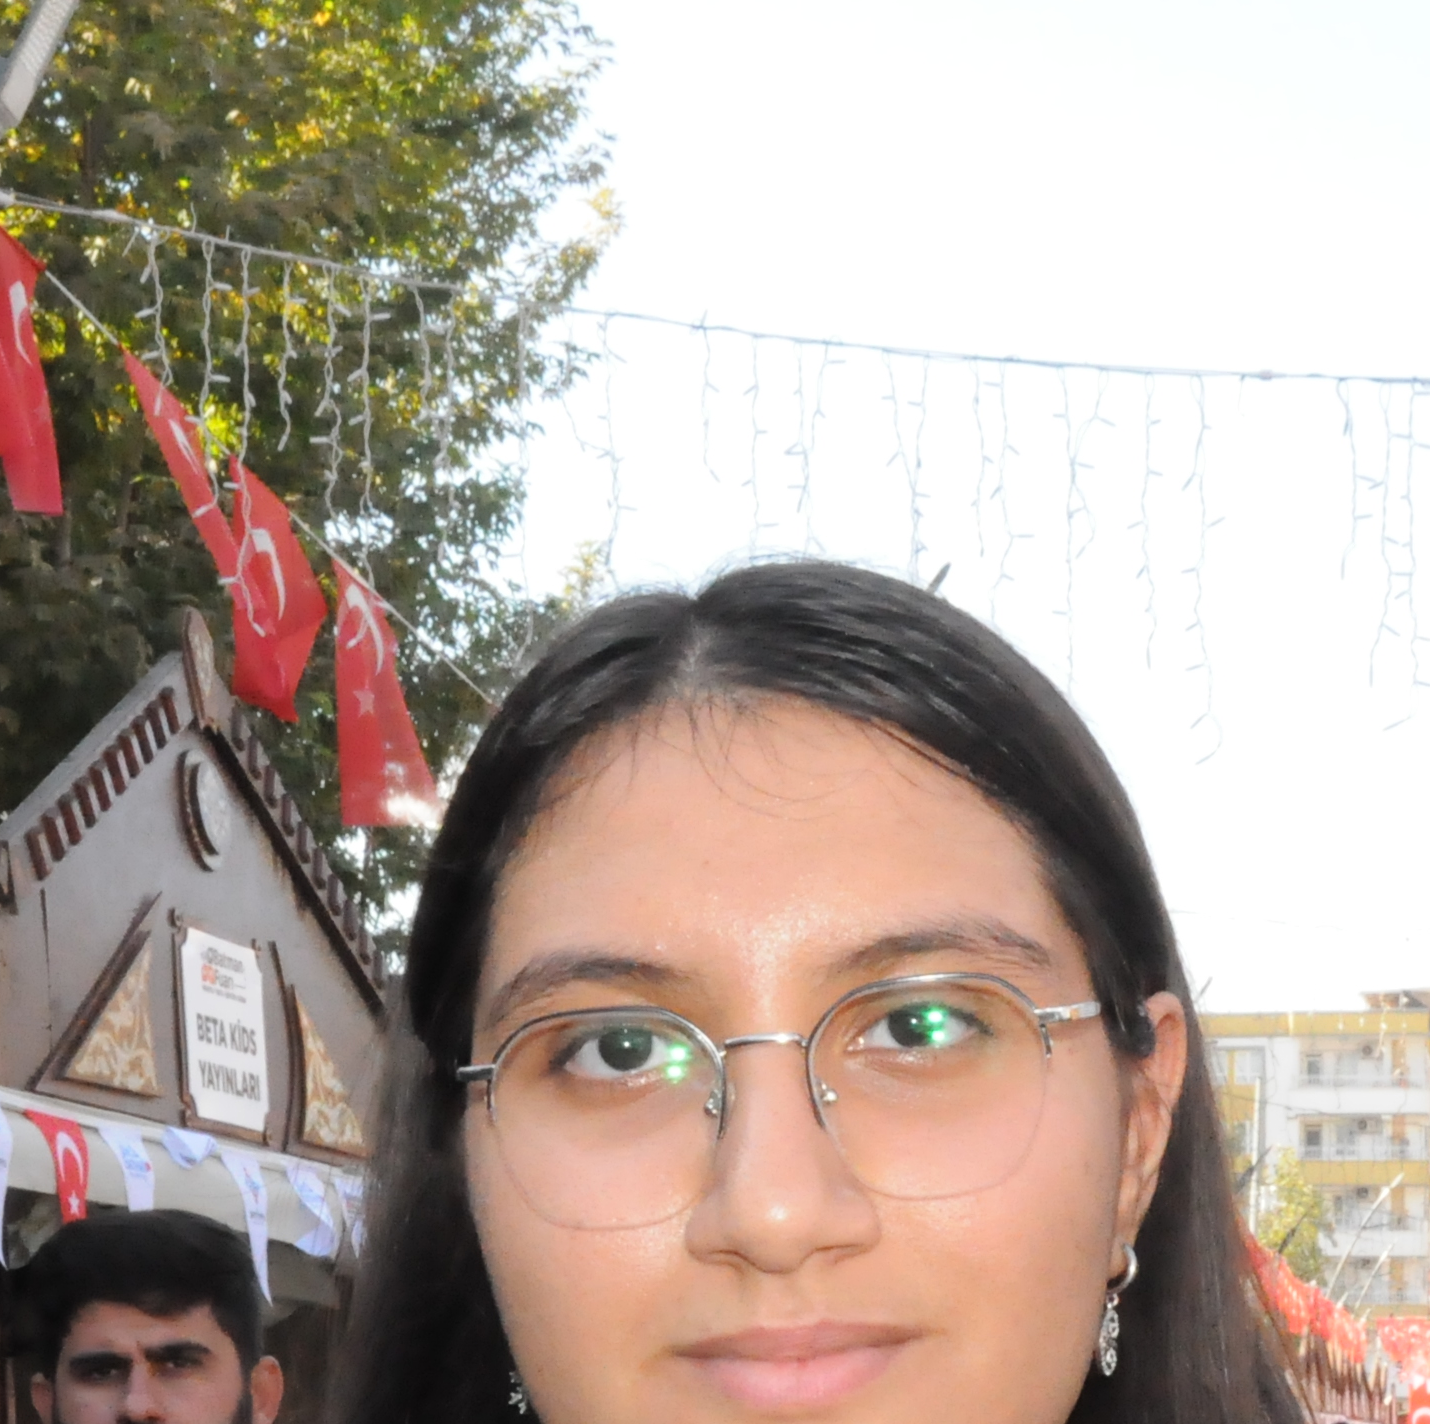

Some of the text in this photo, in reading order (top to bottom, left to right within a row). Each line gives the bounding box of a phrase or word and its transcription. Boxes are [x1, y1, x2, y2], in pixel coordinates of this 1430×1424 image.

[196, 1012, 257, 1056] BETA KİDS
[198, 1059, 261, 1101] YAYINLARI
